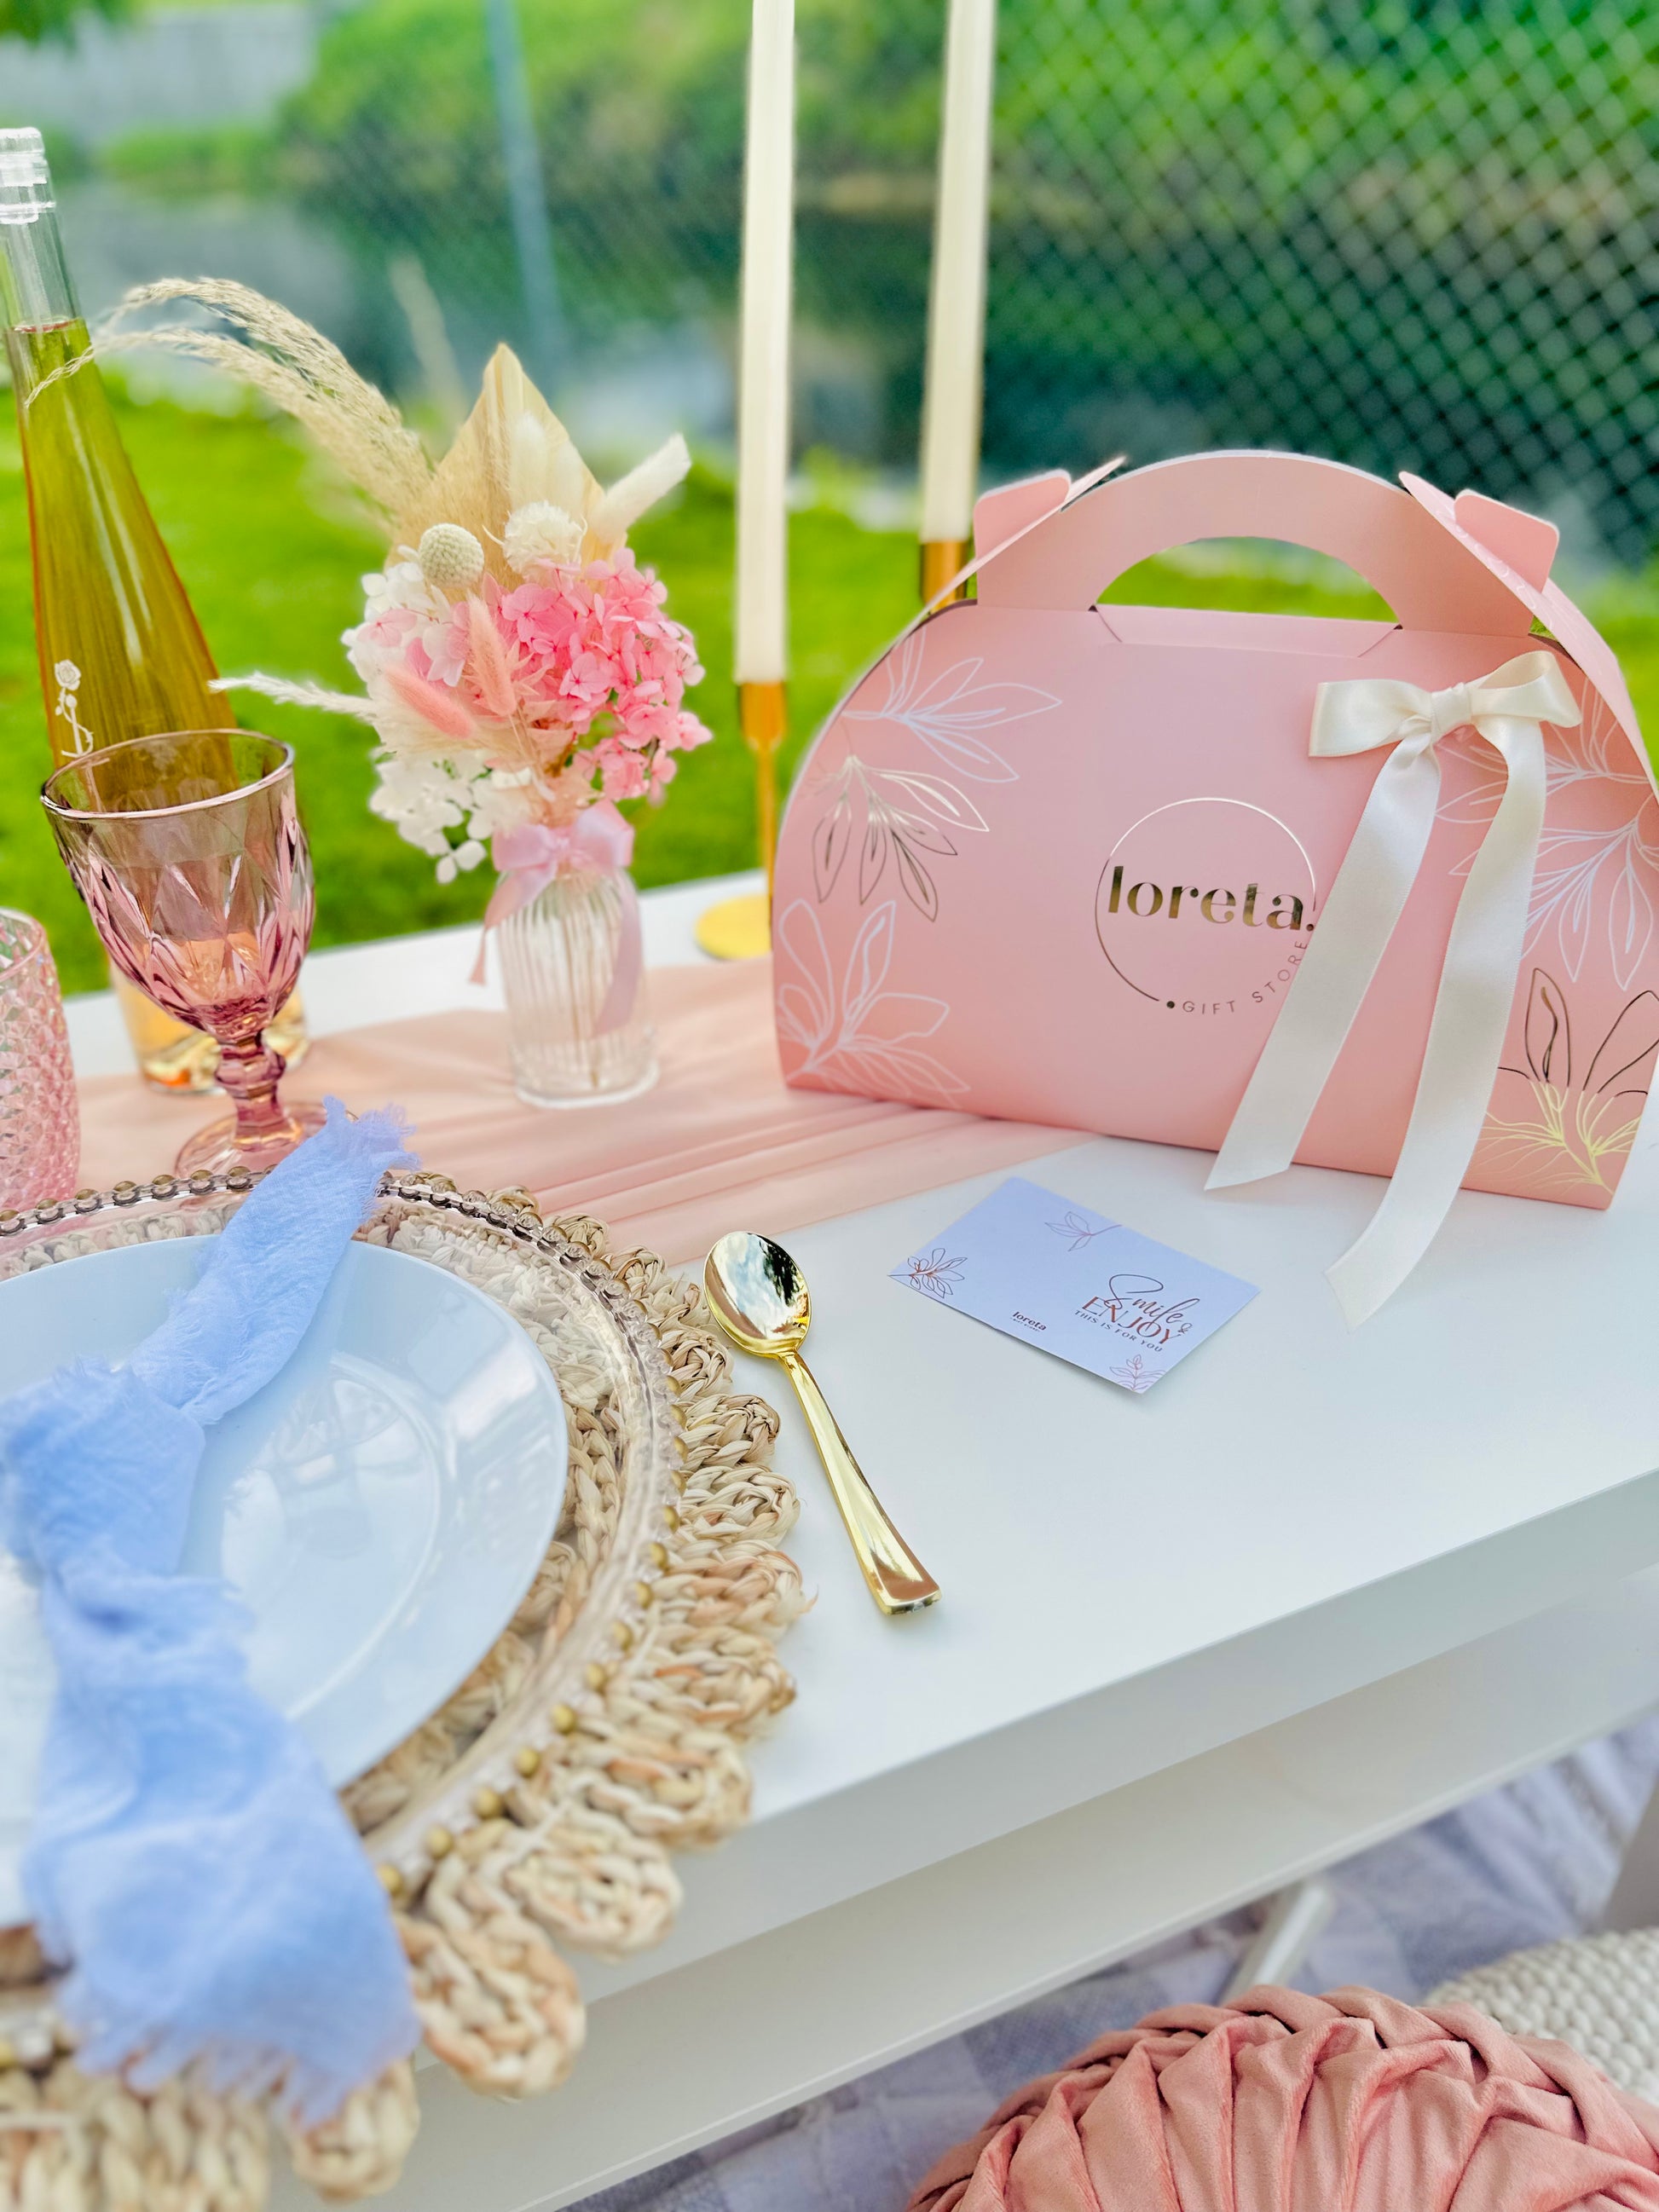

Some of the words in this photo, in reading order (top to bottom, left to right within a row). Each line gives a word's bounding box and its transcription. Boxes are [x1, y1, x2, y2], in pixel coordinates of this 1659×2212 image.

[1182, 1000, 1236, 1015] GIFT
[1251, 940, 1309, 1003] STORE
[1012, 1311, 1047, 1331] loreta
[1082, 1296, 1182, 1344] ENJOY
[1104, 1273, 1200, 1331] Smile
[1074, 1309, 1098, 1324] THIS
[1101, 1322, 1113, 1331] IS
[1114, 1328, 1137, 1342] FOR
[1140, 1340, 1163, 1353] YOU
